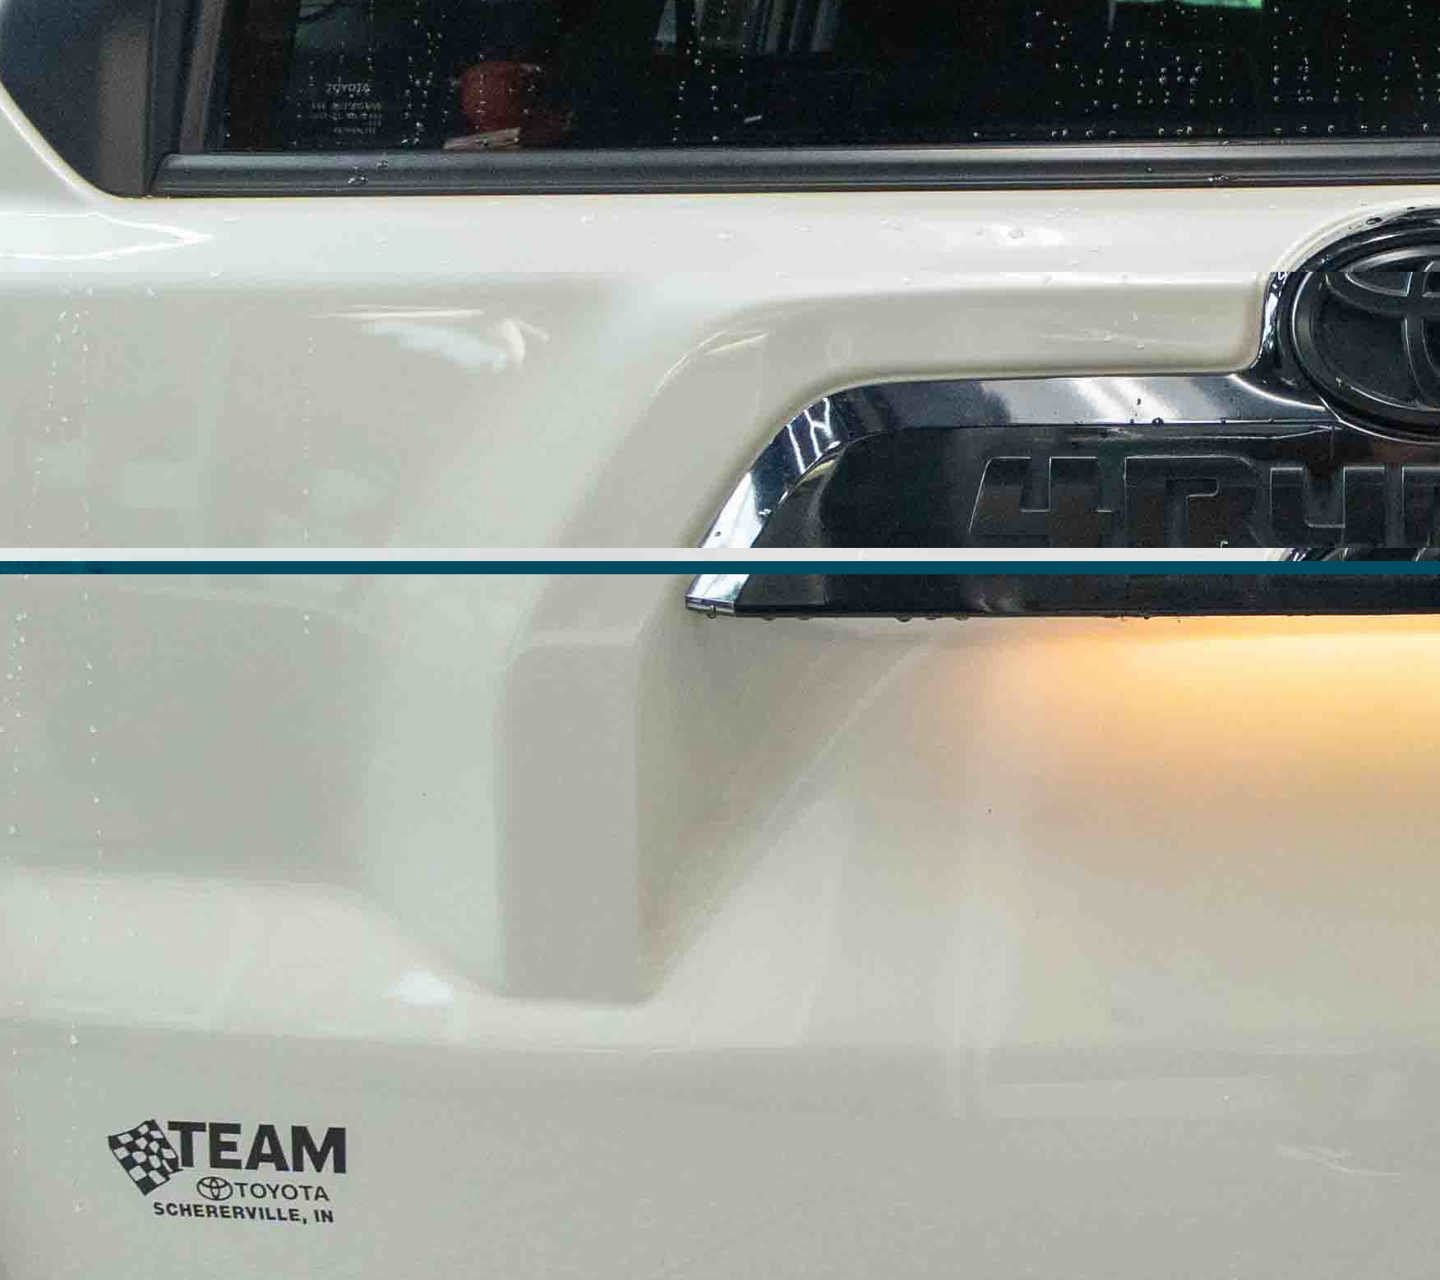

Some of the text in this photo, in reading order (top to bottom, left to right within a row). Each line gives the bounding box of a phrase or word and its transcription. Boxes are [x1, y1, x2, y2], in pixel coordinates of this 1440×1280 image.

[167, 1120, 347, 1174] TEAM
[234, 1182, 330, 1202] TOYOTA
[153, 1201, 334, 1224] SCHERERVILLE, IN
